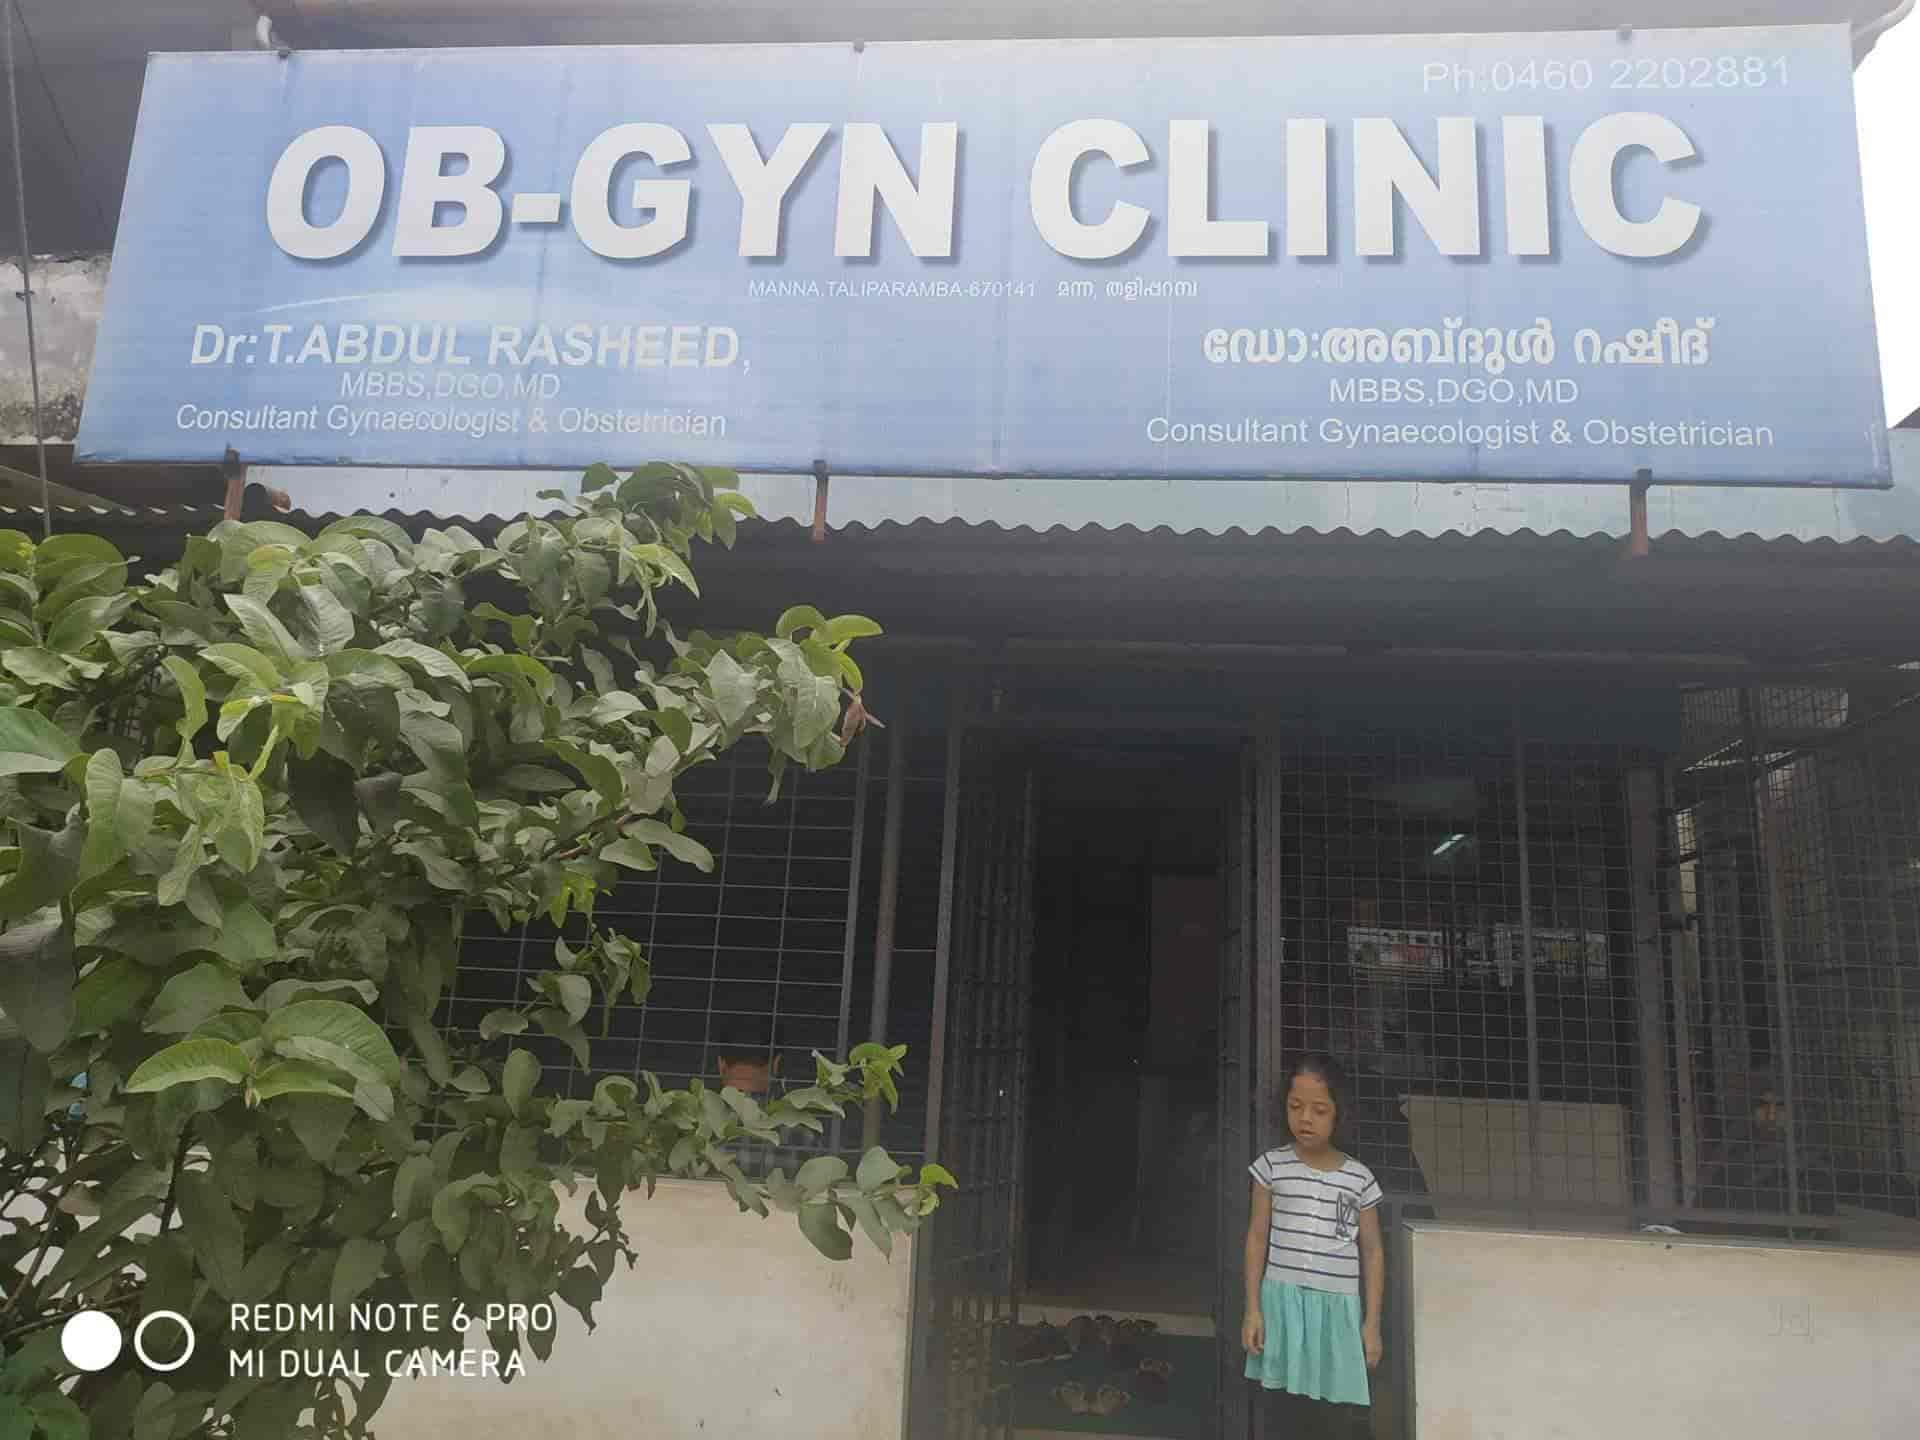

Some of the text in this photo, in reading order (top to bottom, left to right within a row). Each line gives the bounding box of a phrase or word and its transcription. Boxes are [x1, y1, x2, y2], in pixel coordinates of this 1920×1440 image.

[1422, 55, 1791, 93] Ph:0460 2202881
[265, 112, 1702, 260] OB-GYN CLINIC
[190, 324, 750, 375] Dr:T.ABDUL RASHEED,
[1573, 316, 1716, 366] റഷീദ്
[340, 372, 562, 401] MBBS,DGO,MD
[1329, 379, 1580, 407] MBBS,DGO,MD
[176, 404, 727, 437] Consultant Gynaecologist & Obstetrician
[1146, 416, 1774, 450] Consultant Gynaecologist & Obstetrician
